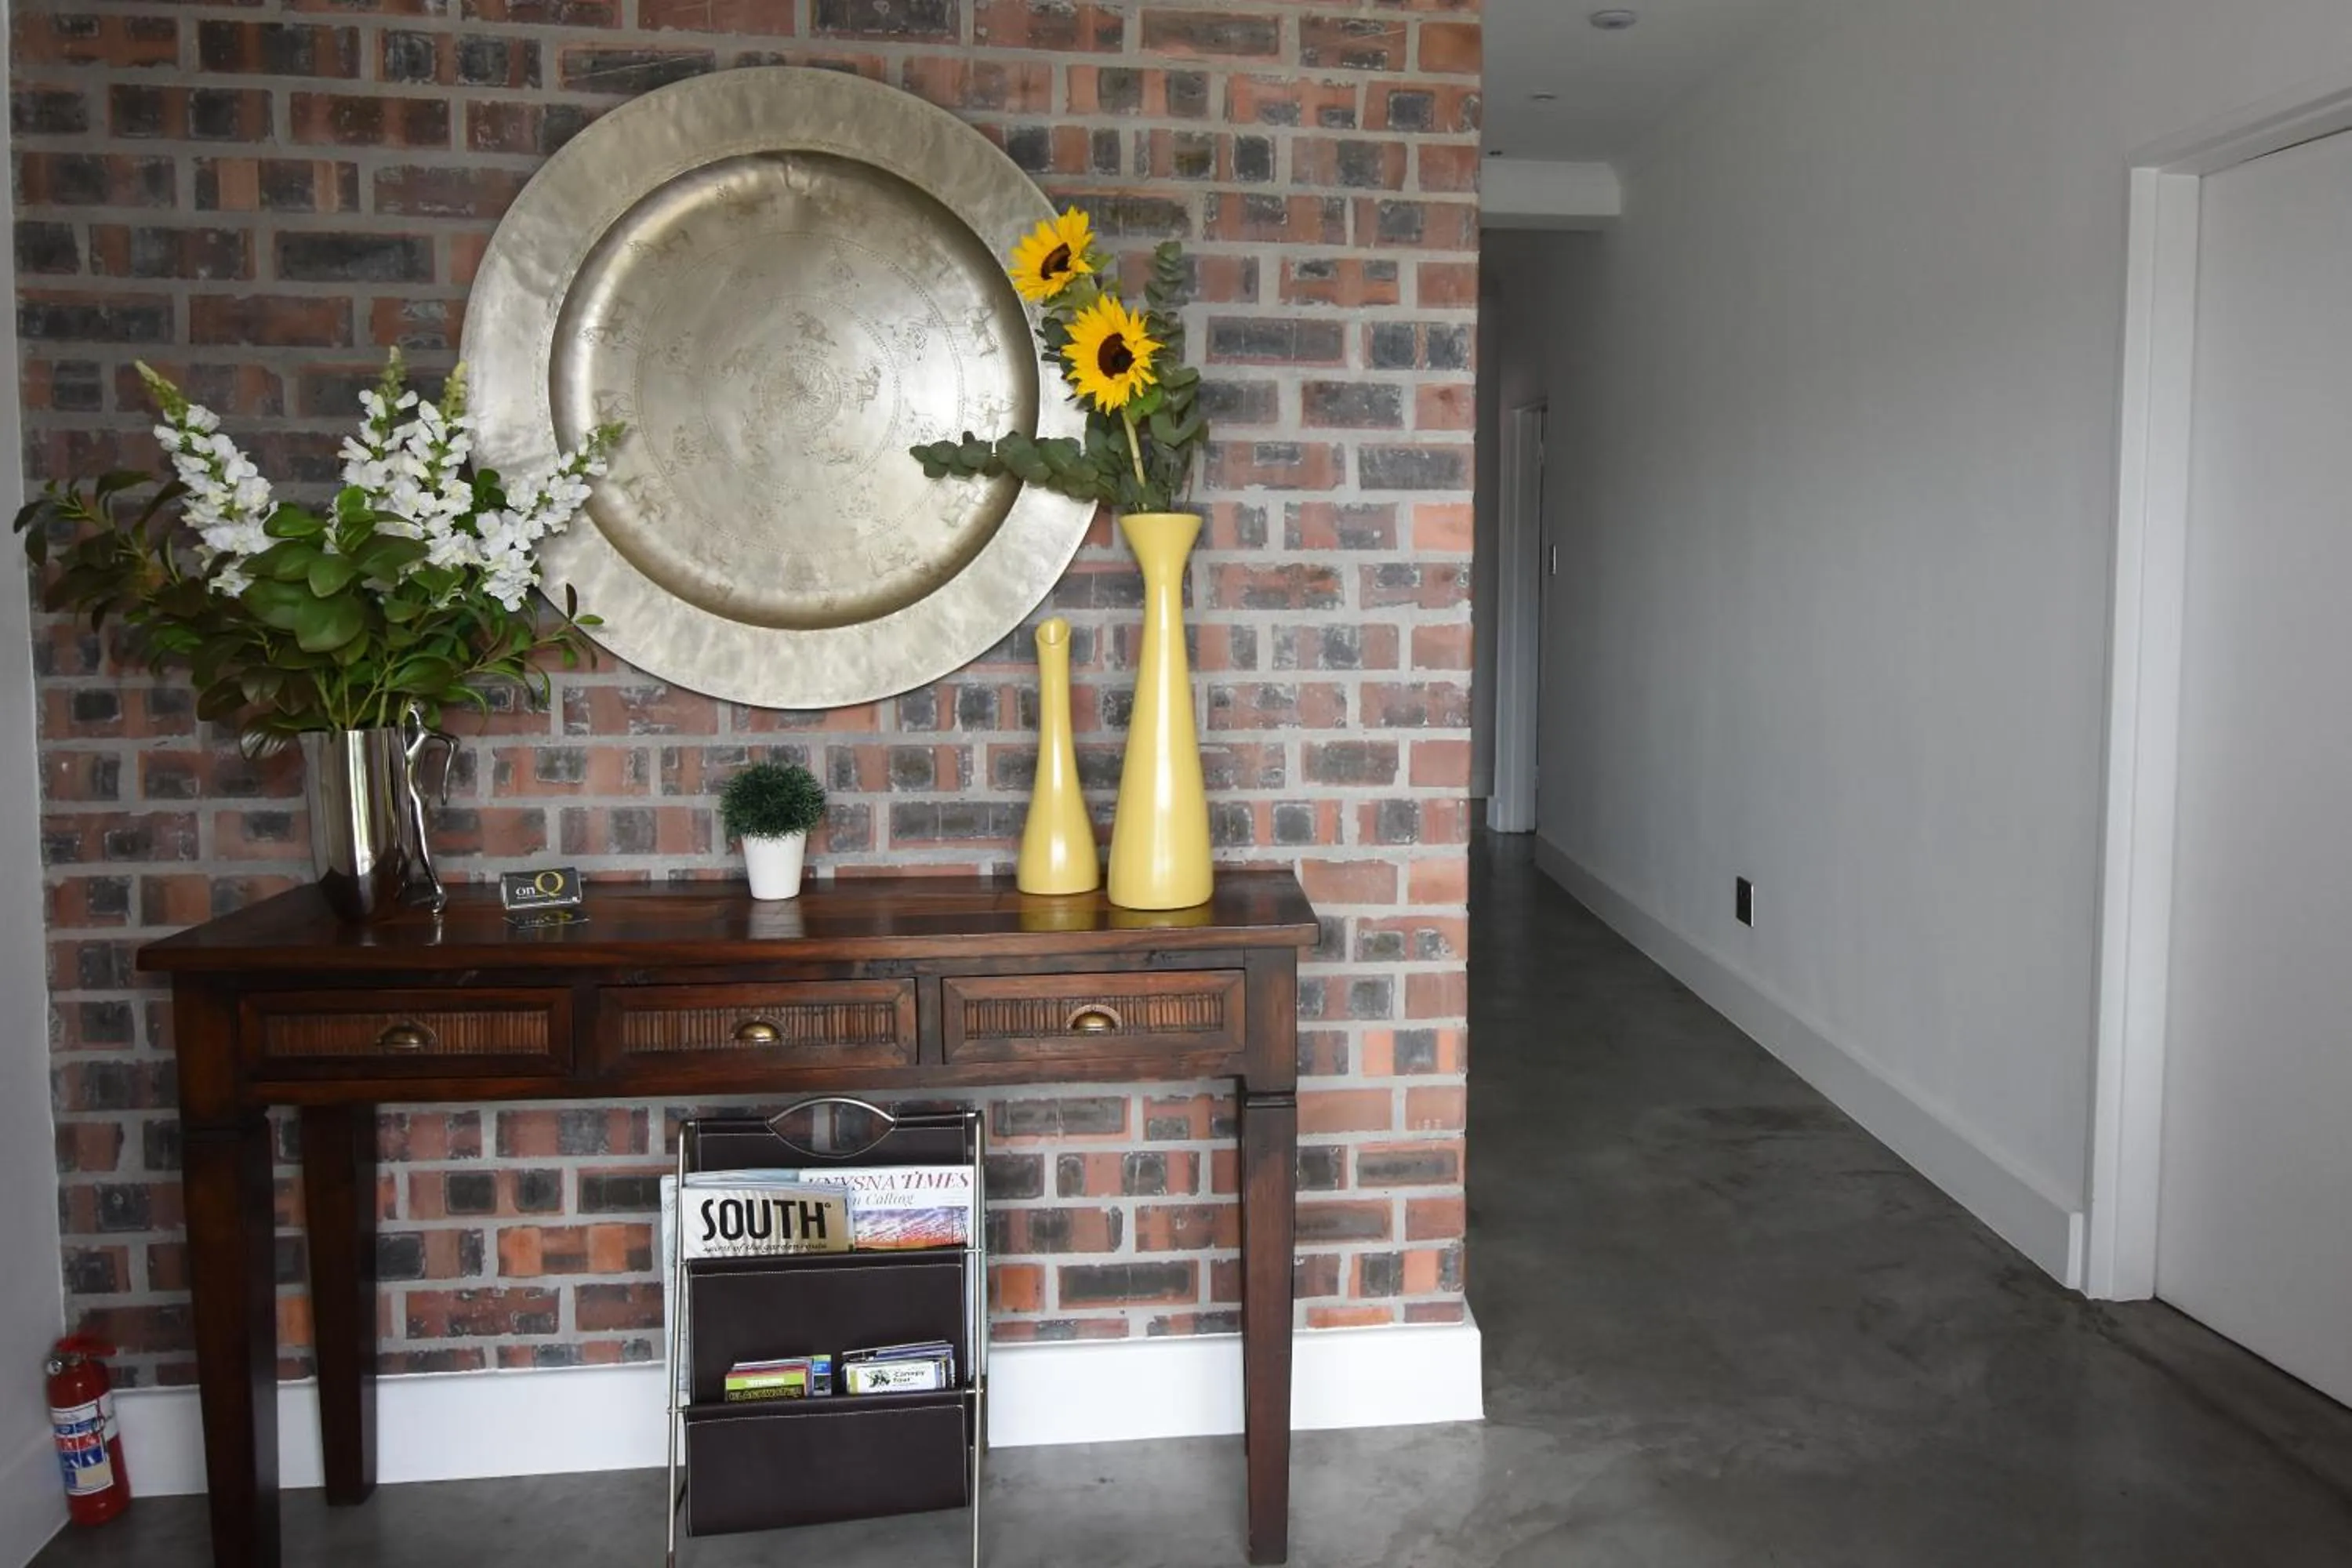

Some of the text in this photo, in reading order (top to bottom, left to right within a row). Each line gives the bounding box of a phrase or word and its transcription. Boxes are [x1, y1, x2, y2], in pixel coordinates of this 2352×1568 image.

[902, 1171, 969, 1189] TIMES
[866, 1192, 915, 1207] Calling
[701, 1199, 827, 1241] SOUTH
